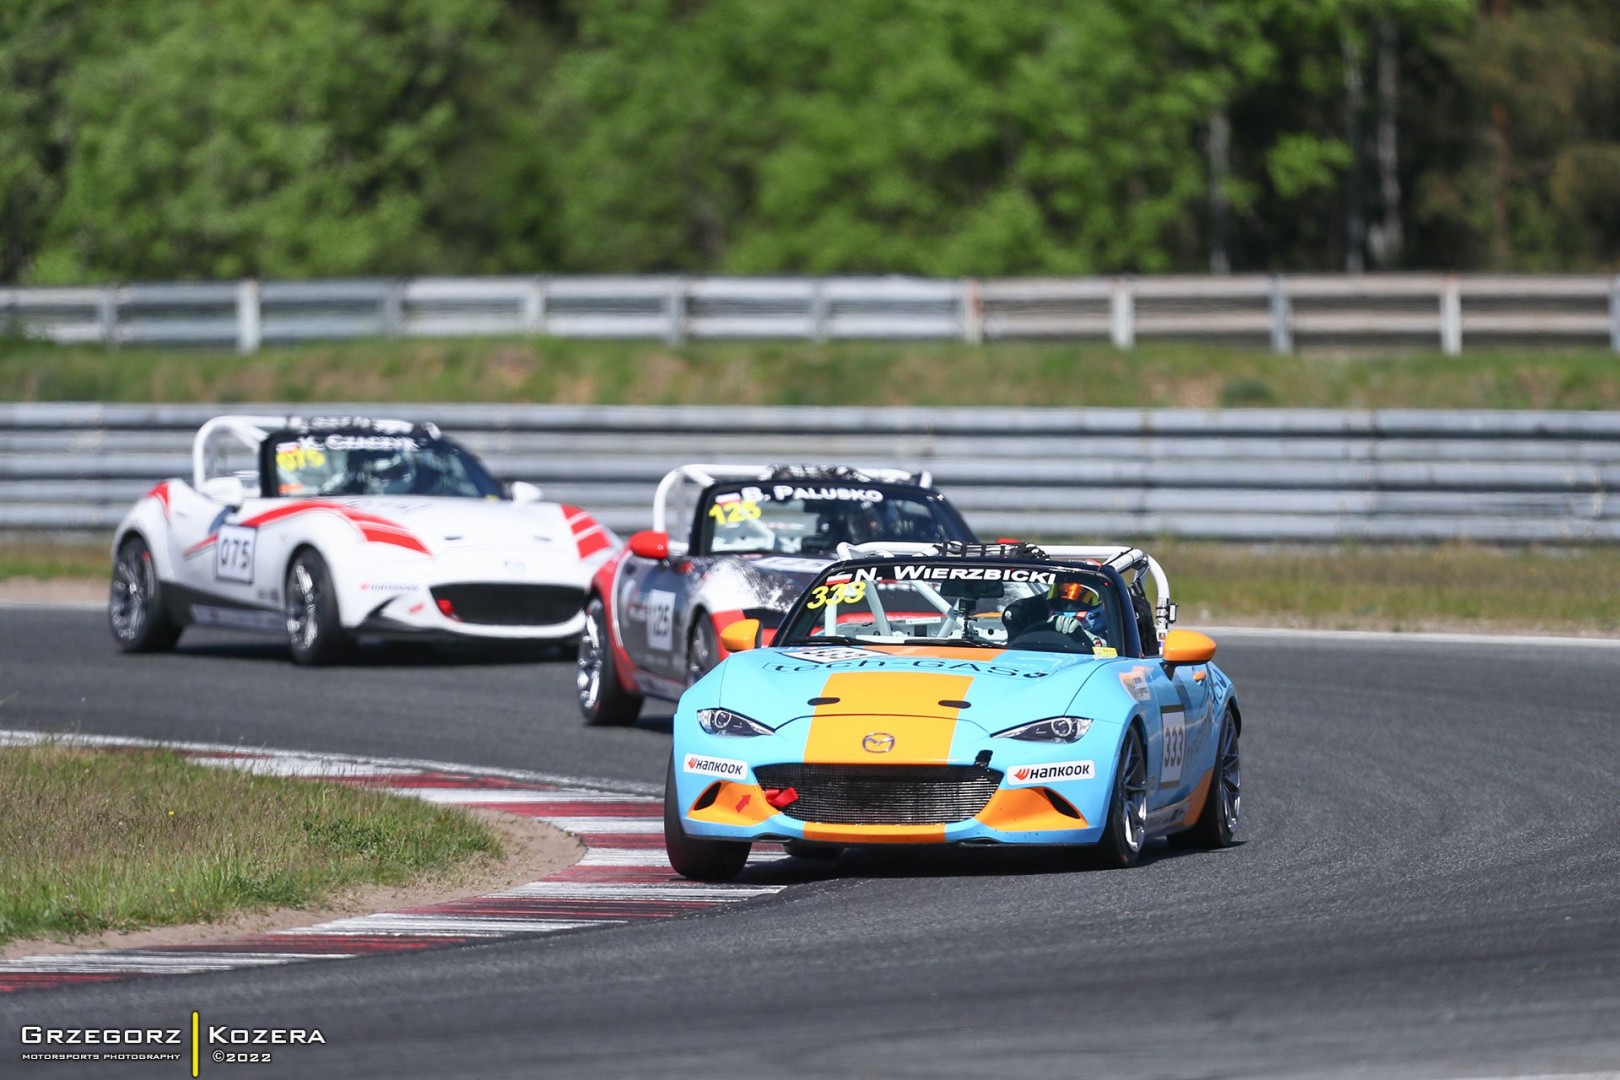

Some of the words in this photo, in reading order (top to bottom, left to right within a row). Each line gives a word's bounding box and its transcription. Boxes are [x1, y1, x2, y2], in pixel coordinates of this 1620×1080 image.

[741, 486, 771, 501] B.
[773, 485, 883, 502] PALUSKO
[220, 538, 250, 569] 075
[855, 567, 883, 582] N.
[894, 565, 1056, 584] WIERZBICKI
[807, 581, 867, 609] 333
[1164, 726, 1183, 768] 333
